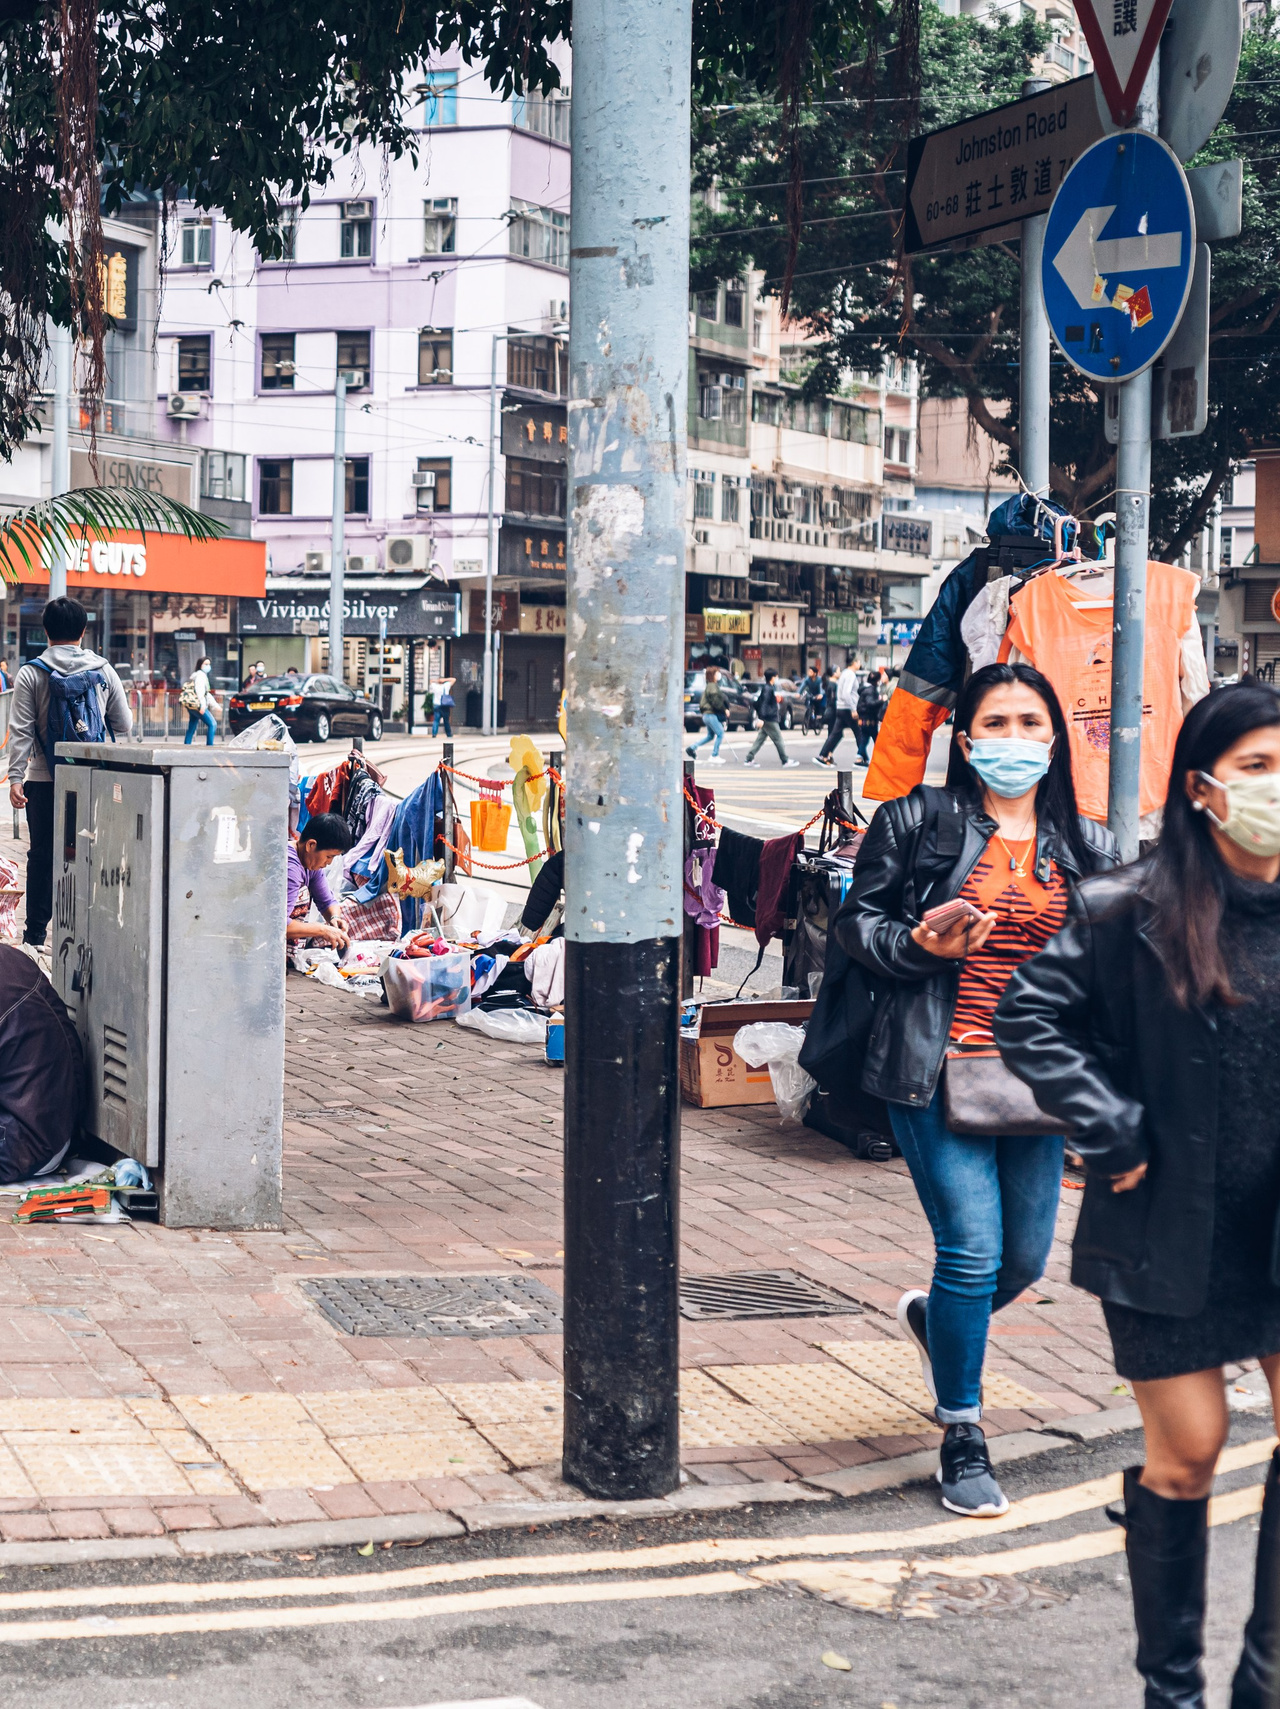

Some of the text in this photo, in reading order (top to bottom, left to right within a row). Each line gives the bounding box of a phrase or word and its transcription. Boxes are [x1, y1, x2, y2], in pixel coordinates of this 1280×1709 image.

[956, 102, 1068, 166] Johnston Road
[926, 194, 959, 222] 60-68
[965, 156, 1052, 218] 莊士敦道
[91, 540, 147, 577] GUYS
[707, 614, 722, 631] SUPER
[728, 615, 746, 632] SAMPLE
[1077, 695, 1108, 707] CH
